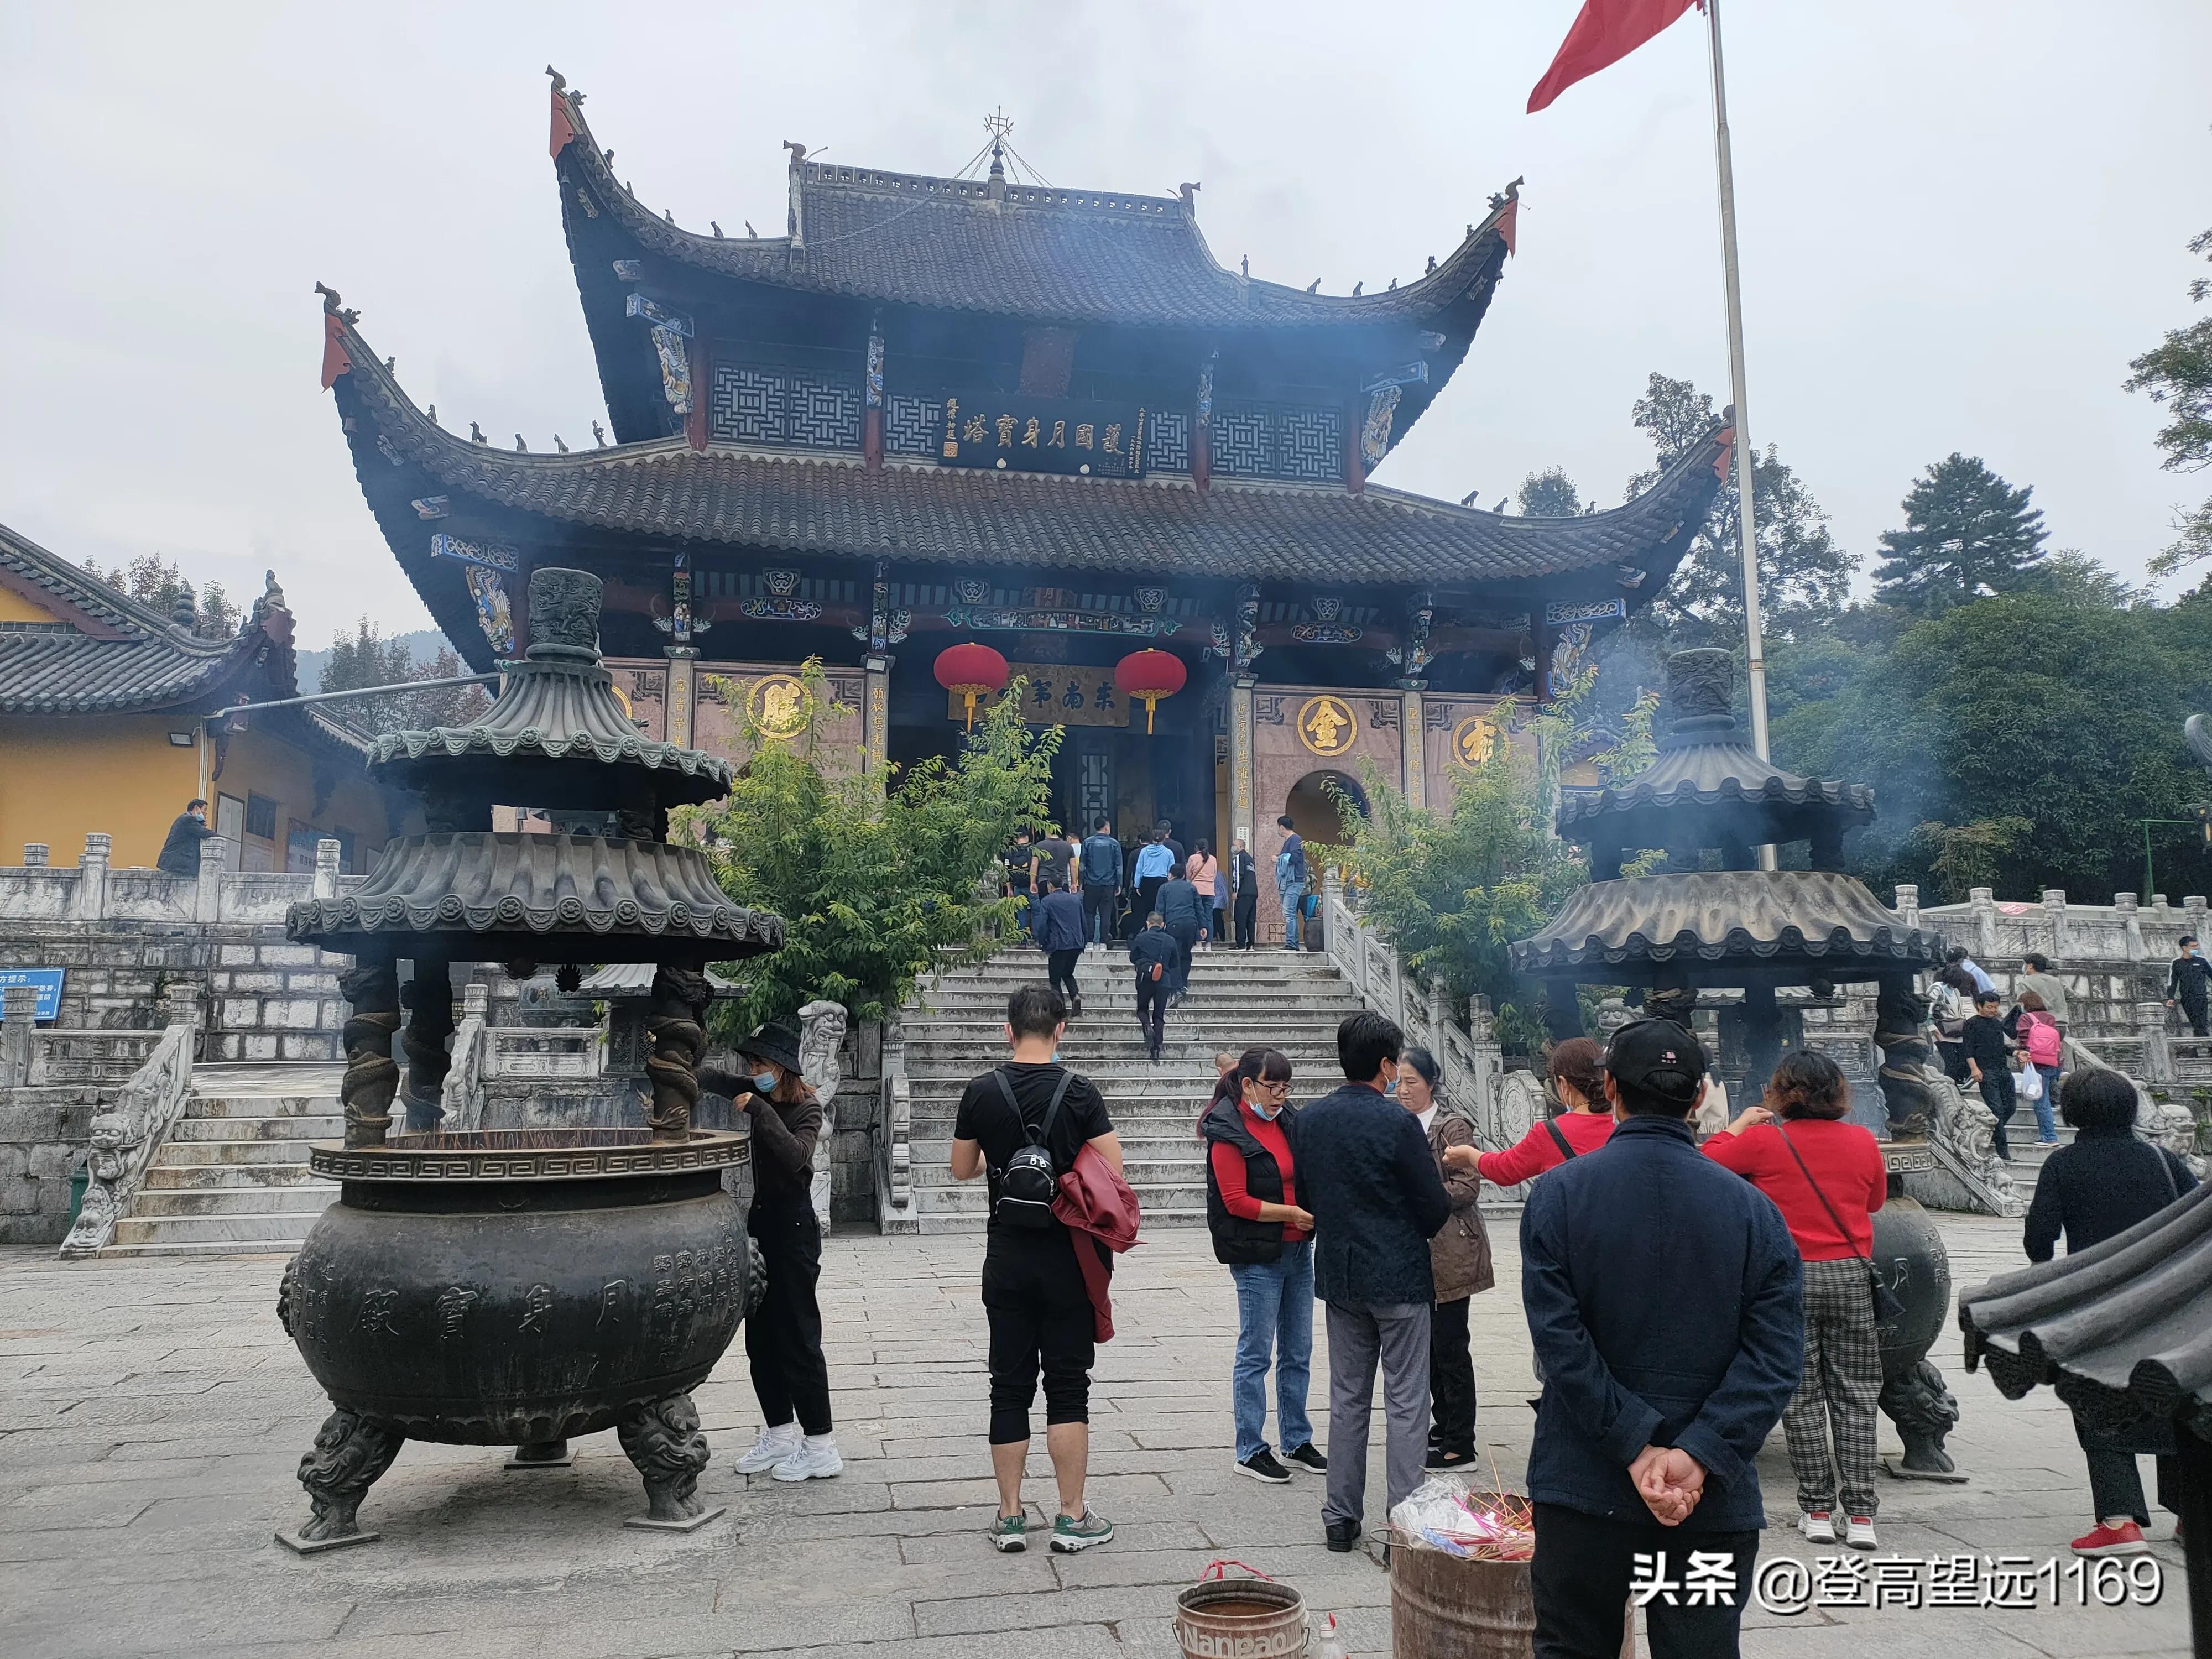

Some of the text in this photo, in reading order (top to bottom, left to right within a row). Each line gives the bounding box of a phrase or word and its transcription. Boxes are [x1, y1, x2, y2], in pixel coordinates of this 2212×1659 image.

[963, 413, 1126, 455] 護國月身寶塔
[1306, 700, 1348, 748] 金
[1183, 1623, 1287, 1657] Nanpao
